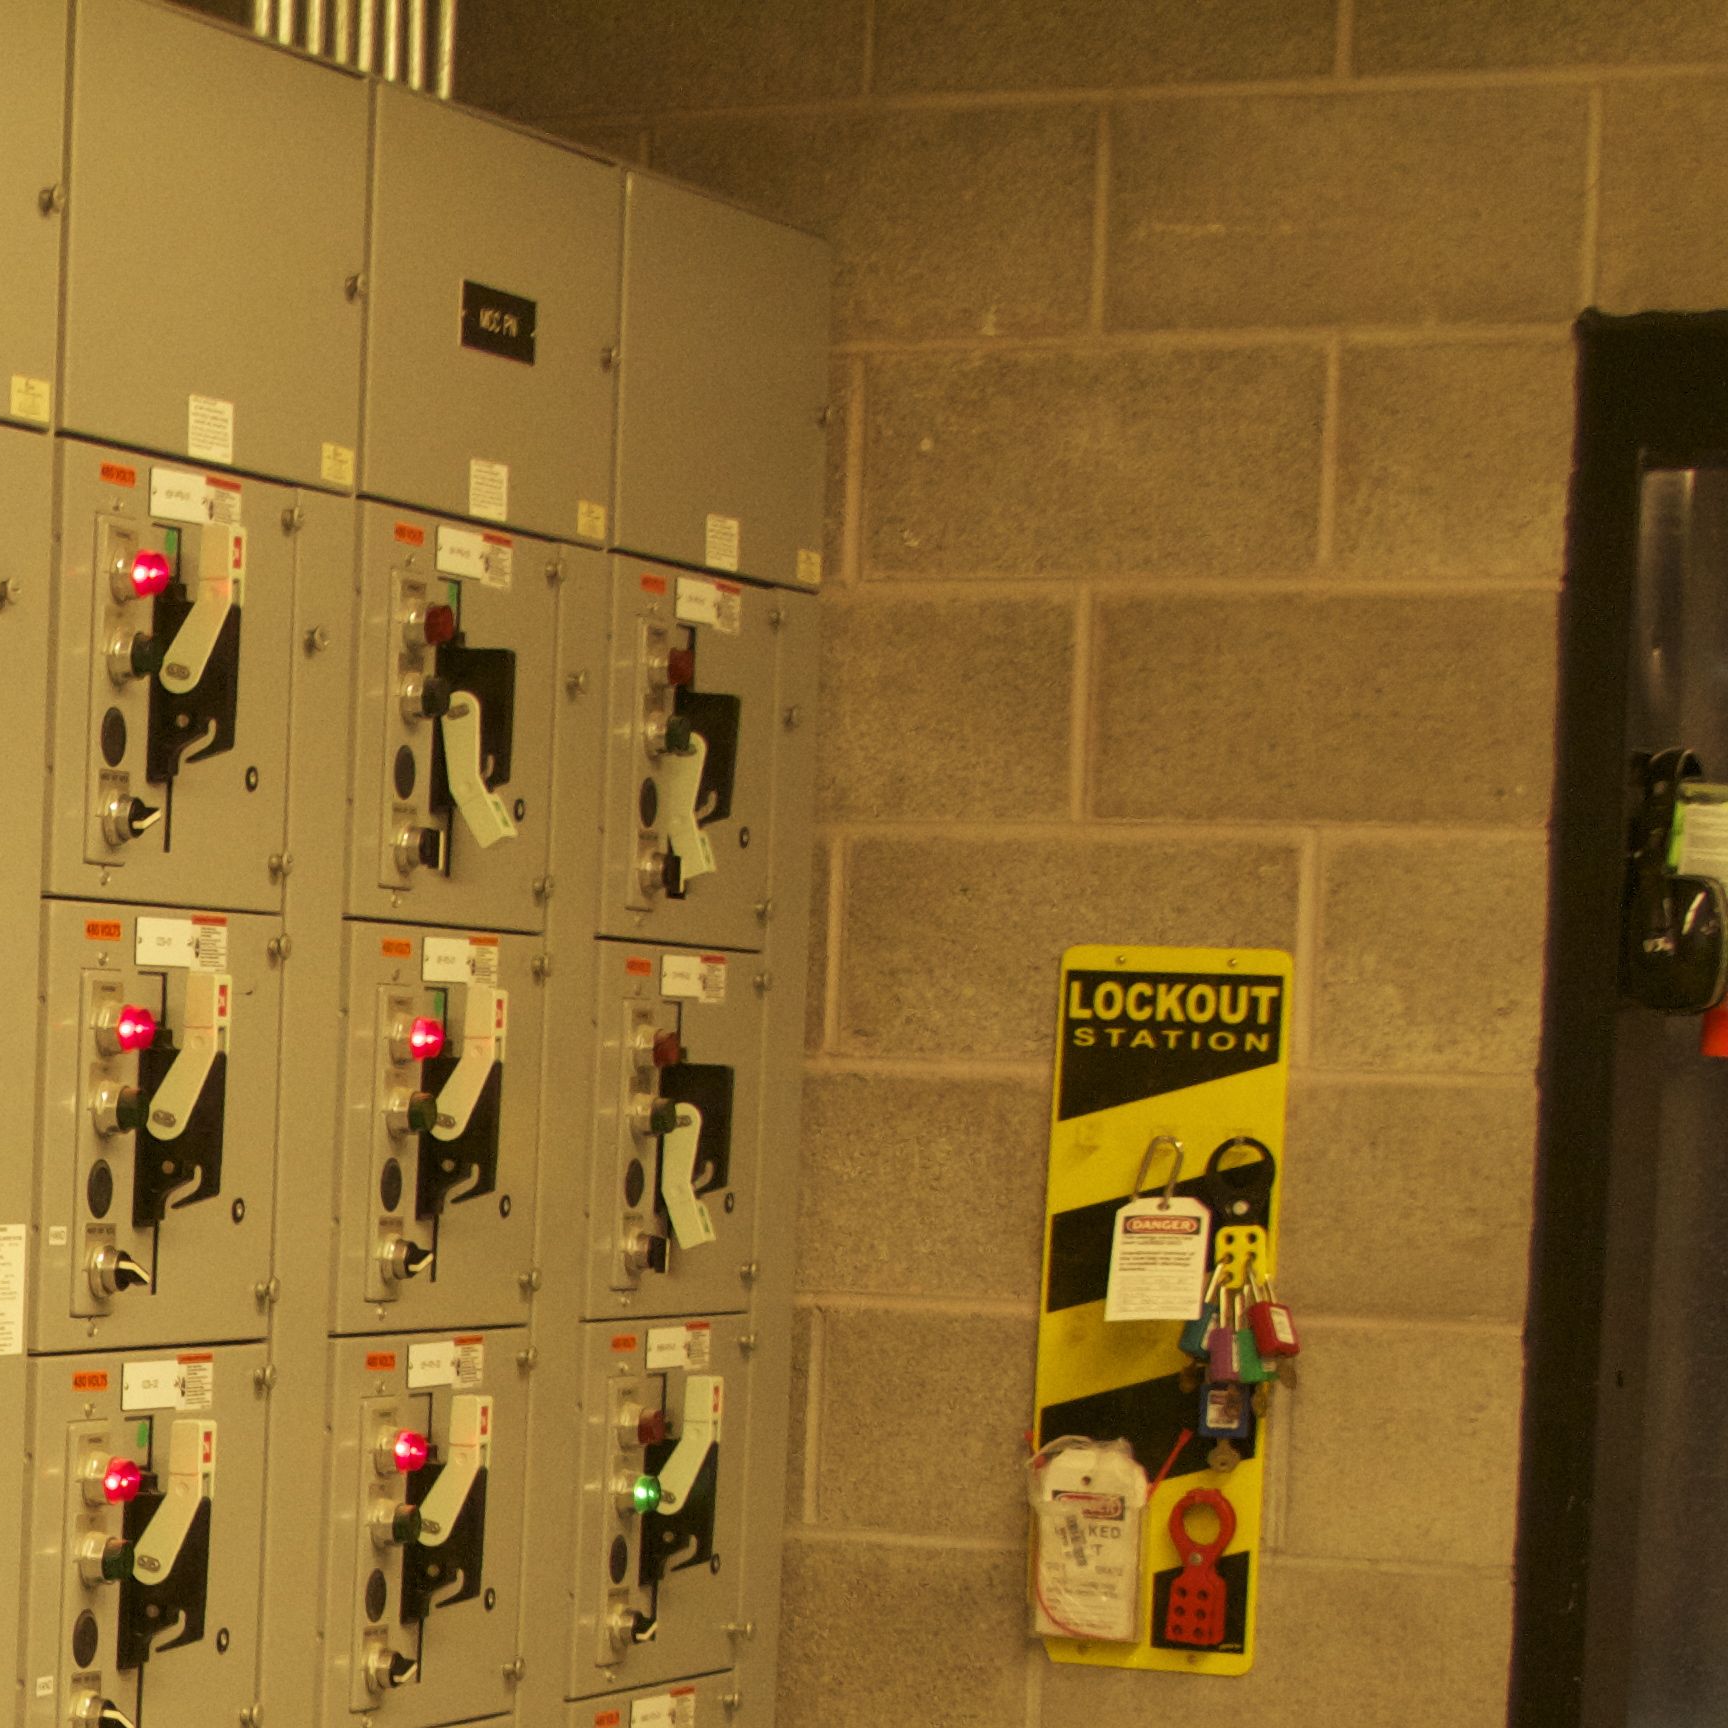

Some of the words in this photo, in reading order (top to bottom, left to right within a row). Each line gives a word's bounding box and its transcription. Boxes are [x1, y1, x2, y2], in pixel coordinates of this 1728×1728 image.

[1068, 981, 1279, 1024] LOCKOUT
[1073, 1028, 1269, 1052] STATION
[1131, 1219, 1196, 1232] DANGER
